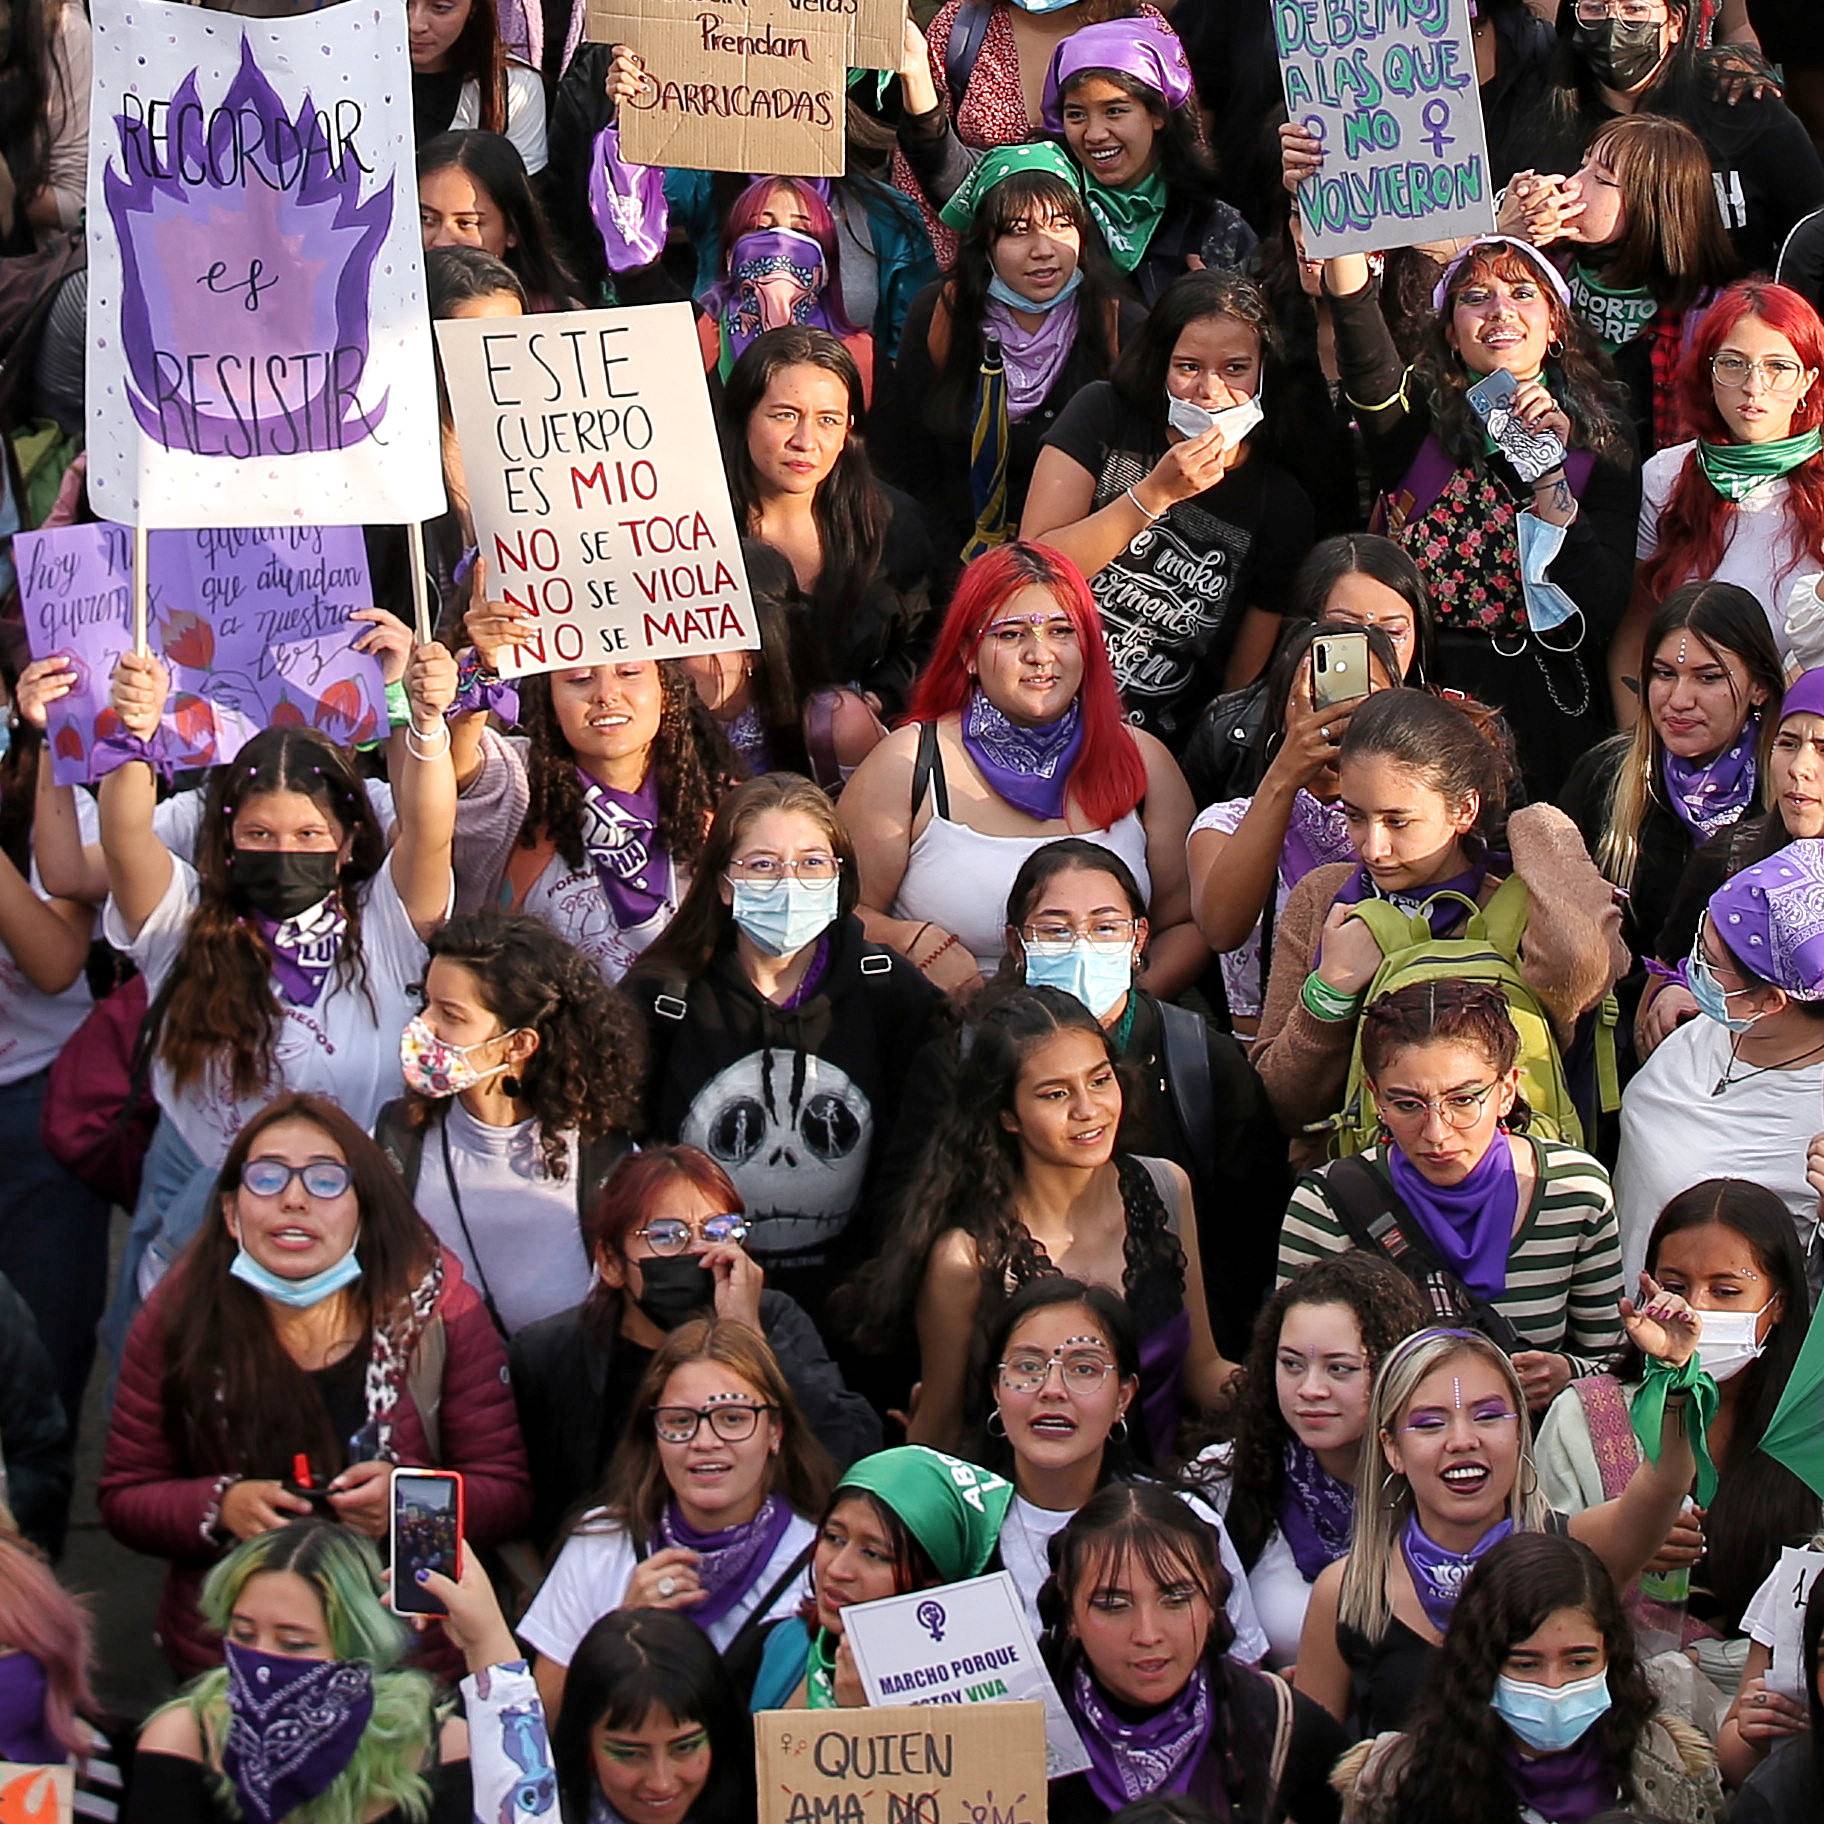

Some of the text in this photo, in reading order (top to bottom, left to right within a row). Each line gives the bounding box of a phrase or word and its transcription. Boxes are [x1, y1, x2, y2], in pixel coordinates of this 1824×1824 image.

[700, 13, 812, 64] Prendan
[1315, 39, 1470, 111] LAS QUE
[120, 92, 376, 194] RECORDAR
[1343, 106, 1401, 161] NO
[1298, 153, 1484, 236] VOLVIERON
[196, 252, 280, 313] es
[482, 326, 642, 406] ESTE
[151, 343, 391, 460] RESISTIR
[496, 403, 654, 463] CUERPO
[502, 460, 660, 519] ES MIO
[493, 510, 718, 574] NO SE TOCA
[502, 561, 740, 619] NO SE VIOLA
[512, 603, 747, 671] NO SE MATA
[878, 1645, 1020, 1695] MARCHO PORQUE
[964, 1678, 1009, 1702] VIVA
[814, 1731, 953, 1779] QUIEN
